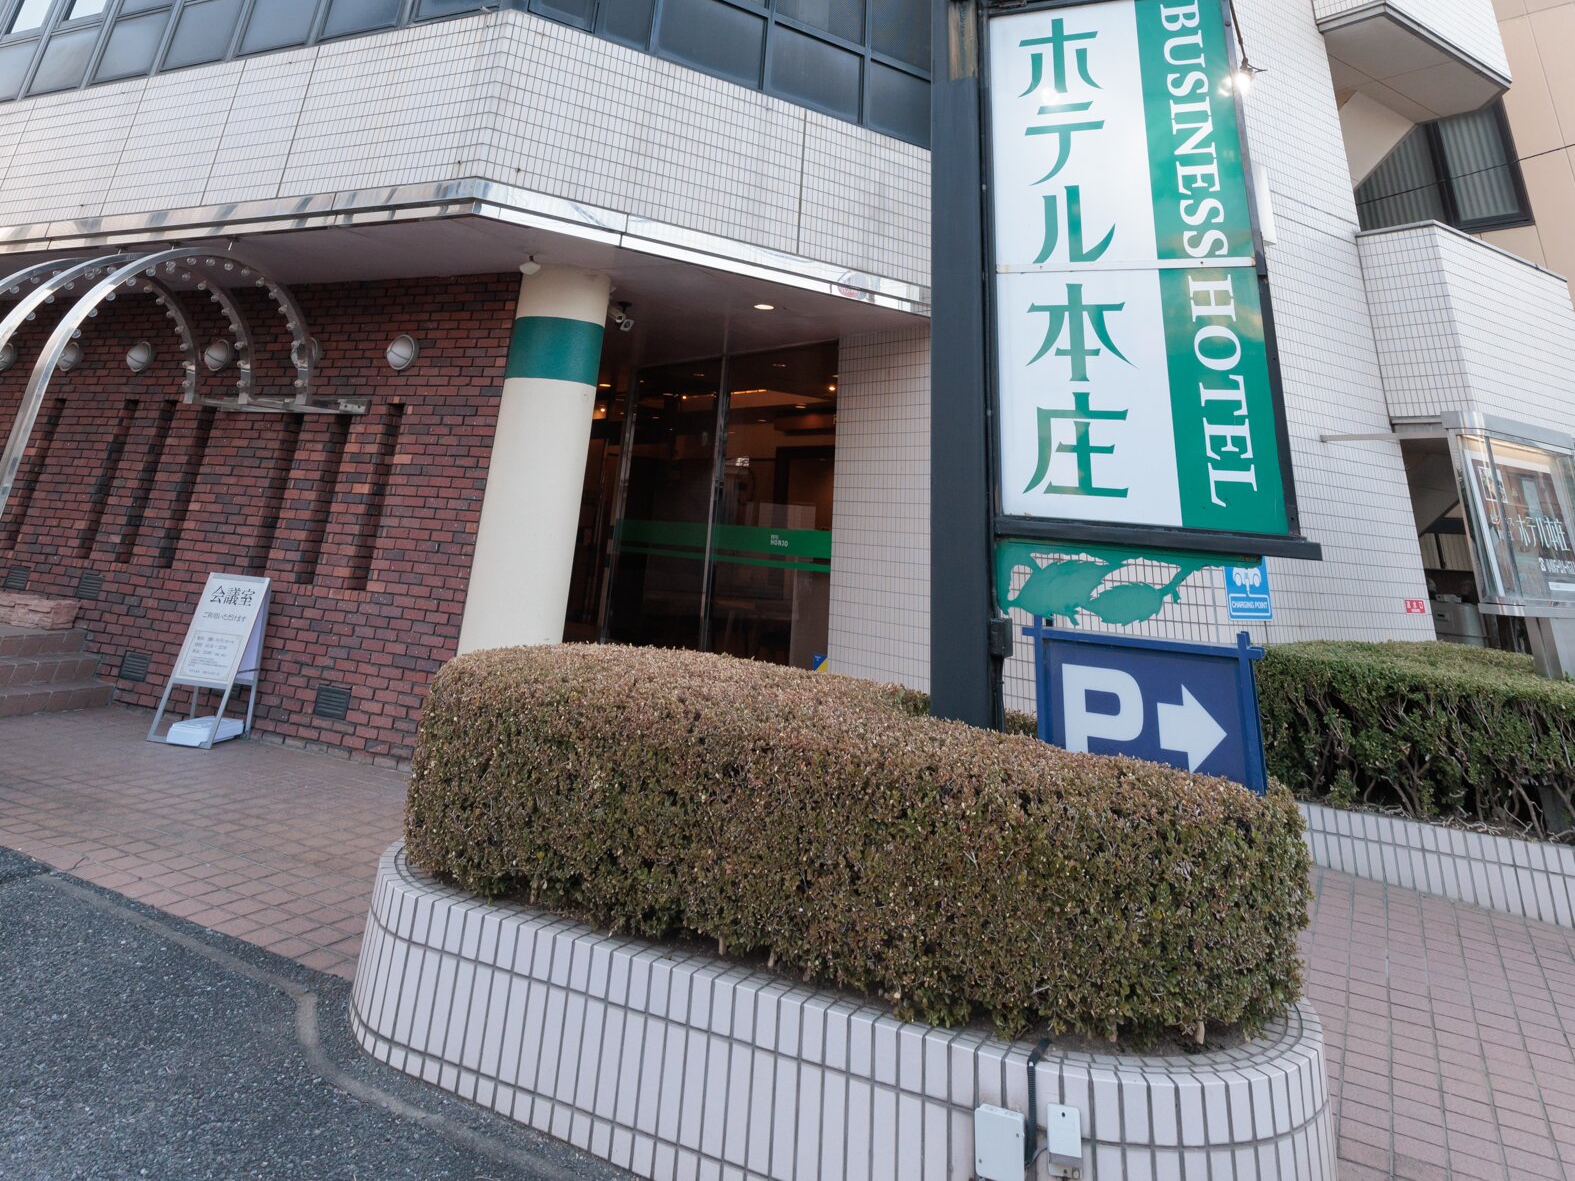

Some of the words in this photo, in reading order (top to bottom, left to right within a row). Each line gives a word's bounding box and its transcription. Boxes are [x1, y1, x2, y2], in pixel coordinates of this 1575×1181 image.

[1160, 0, 1229, 258] BUSINESS
[1018, 17, 1138, 499] ホテル本庄
[1185, 272, 1257, 507] HOTEL
[1516, 514, 1570, 552] ホテル本庄
[209, 585, 255, 606] 会議室
[1231, 601, 1254, 609] CHARGING
[1254, 601, 1268, 609] POINT
[1062, 663, 1144, 754] P
